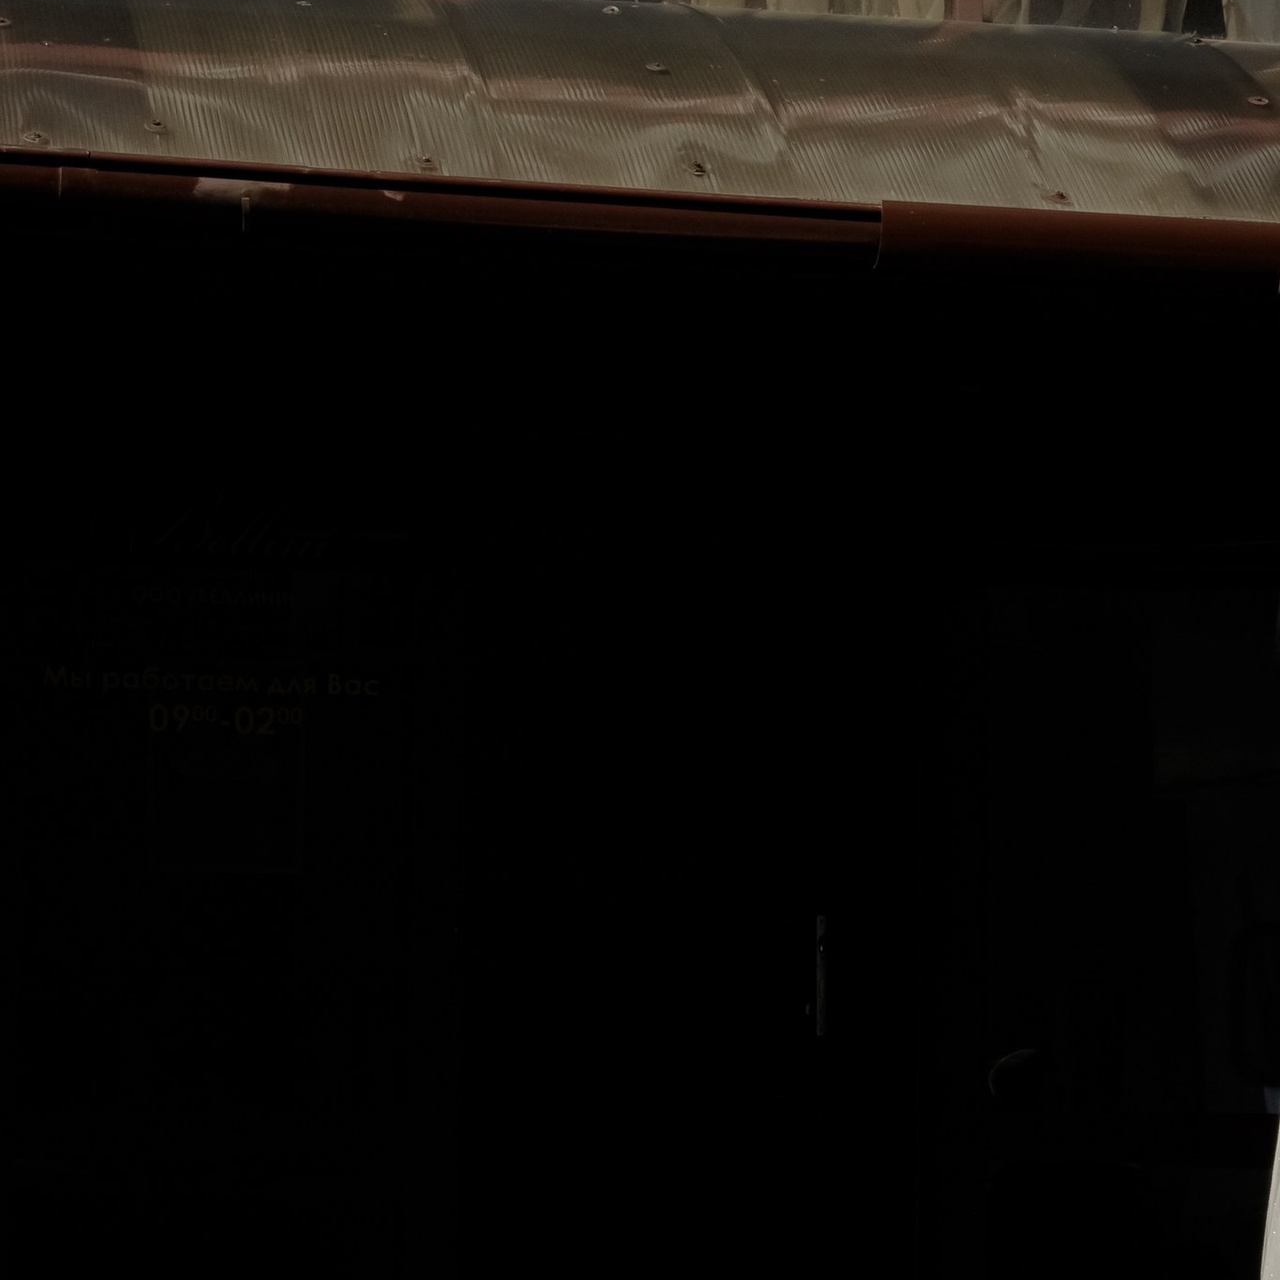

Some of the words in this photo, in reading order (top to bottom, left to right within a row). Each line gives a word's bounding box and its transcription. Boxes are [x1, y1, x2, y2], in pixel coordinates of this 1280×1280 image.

[42, 664, 92, 688] Мы
[103, 668, 259, 693] работаем
[266, 677, 317, 696] для
[327, 673, 381, 696] Вас
